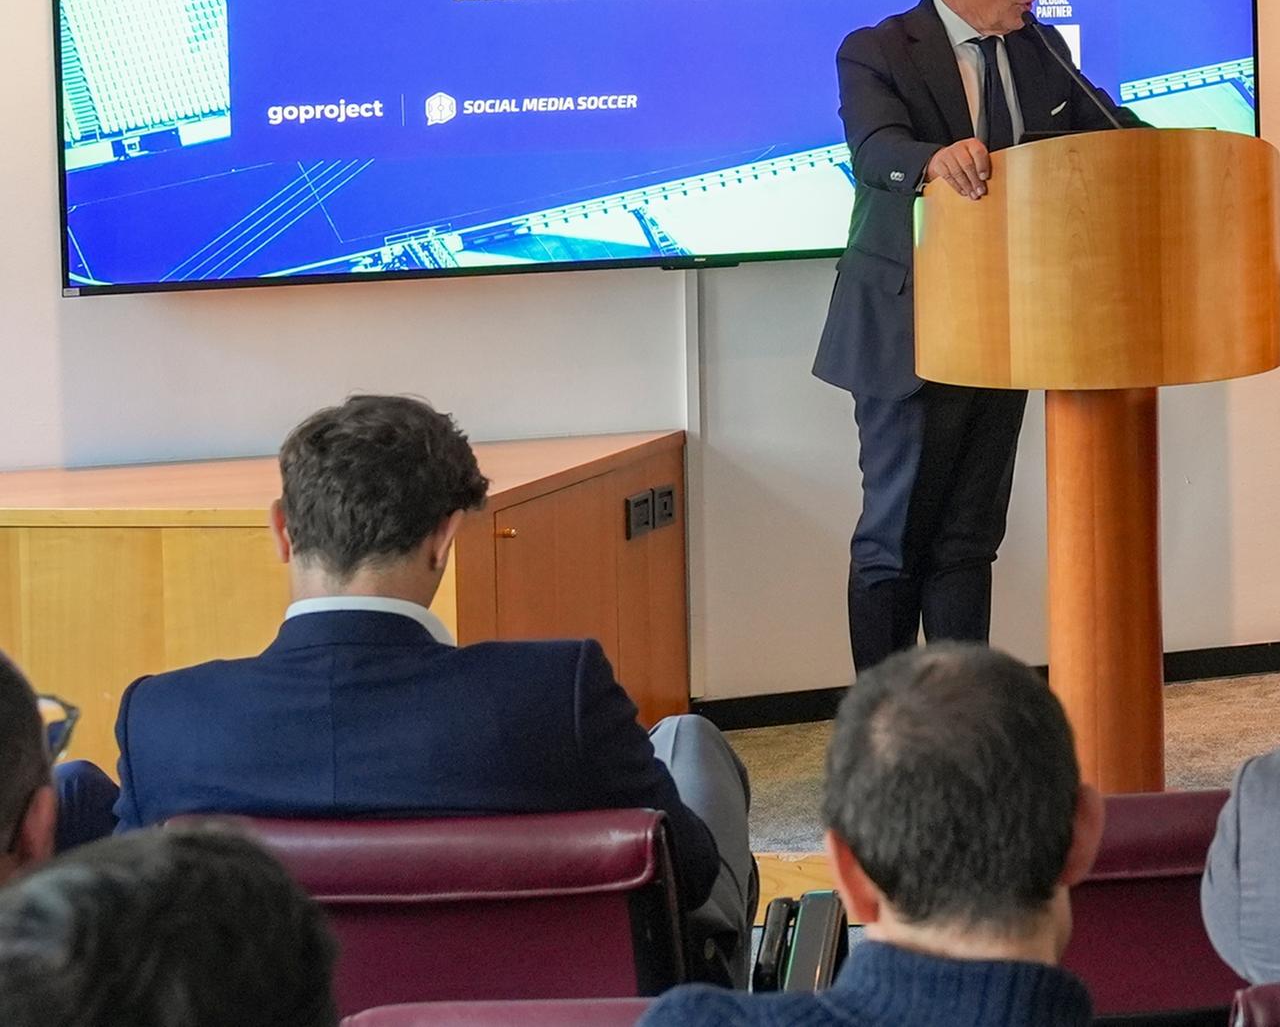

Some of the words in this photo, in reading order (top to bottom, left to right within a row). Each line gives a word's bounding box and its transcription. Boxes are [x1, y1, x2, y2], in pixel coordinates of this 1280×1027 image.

[1036, 6, 1072, 18] PARTNER
[267, 99, 383, 125] goproject
[463, 99, 520, 115] SOCIAL
[523, 97, 574, 112] MEDIA
[577, 94, 638, 110] SOCCER
